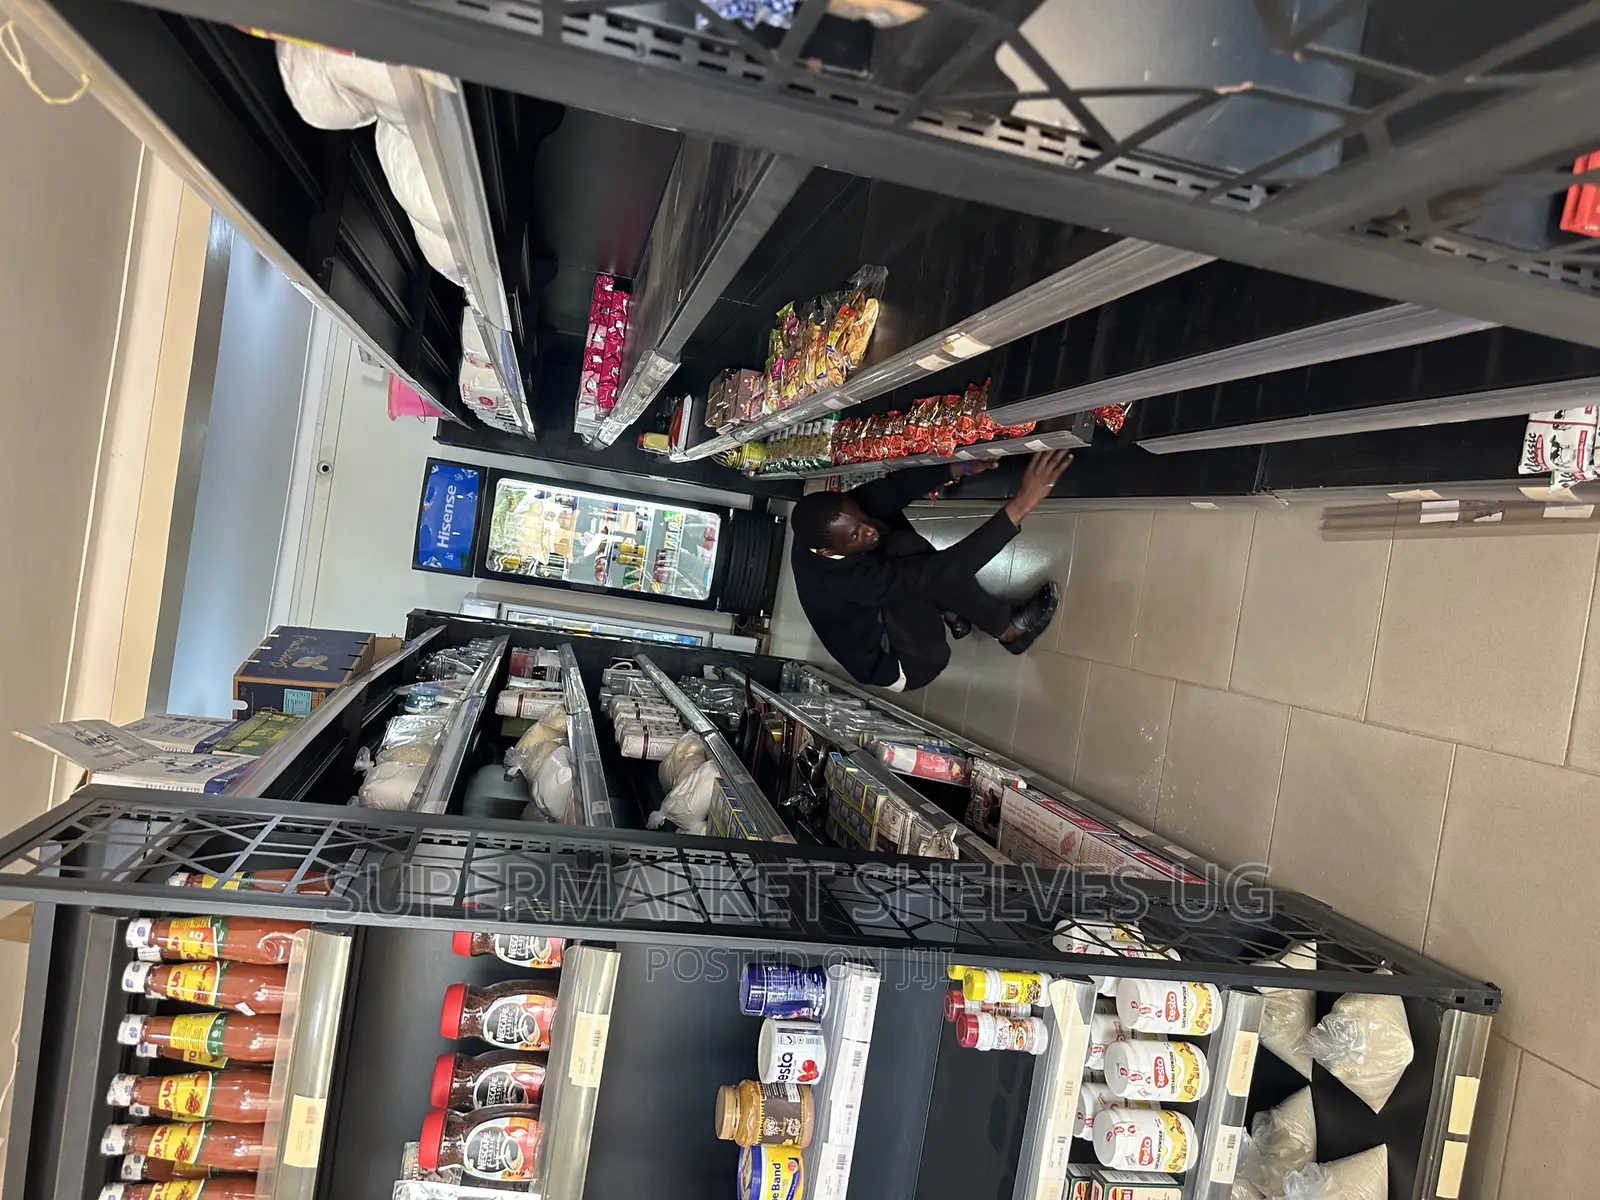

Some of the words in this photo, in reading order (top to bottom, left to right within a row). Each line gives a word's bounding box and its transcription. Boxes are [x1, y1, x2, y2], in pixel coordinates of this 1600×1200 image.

[436, 484, 457, 548] Hisense
[505, 1011, 514, 1040] CLASSIC
[188, 1051, 198, 1063] TO
[776, 1052, 794, 1083] esta
[1168, 1050, 1176, 1072] POWDER
[487, 1075, 500, 1105] ESCAFÉ
[486, 1136, 497, 1168] CLASSIC
[1156, 1130, 1164, 1153] POWDER
[770, 1162, 782, 1192] Band
